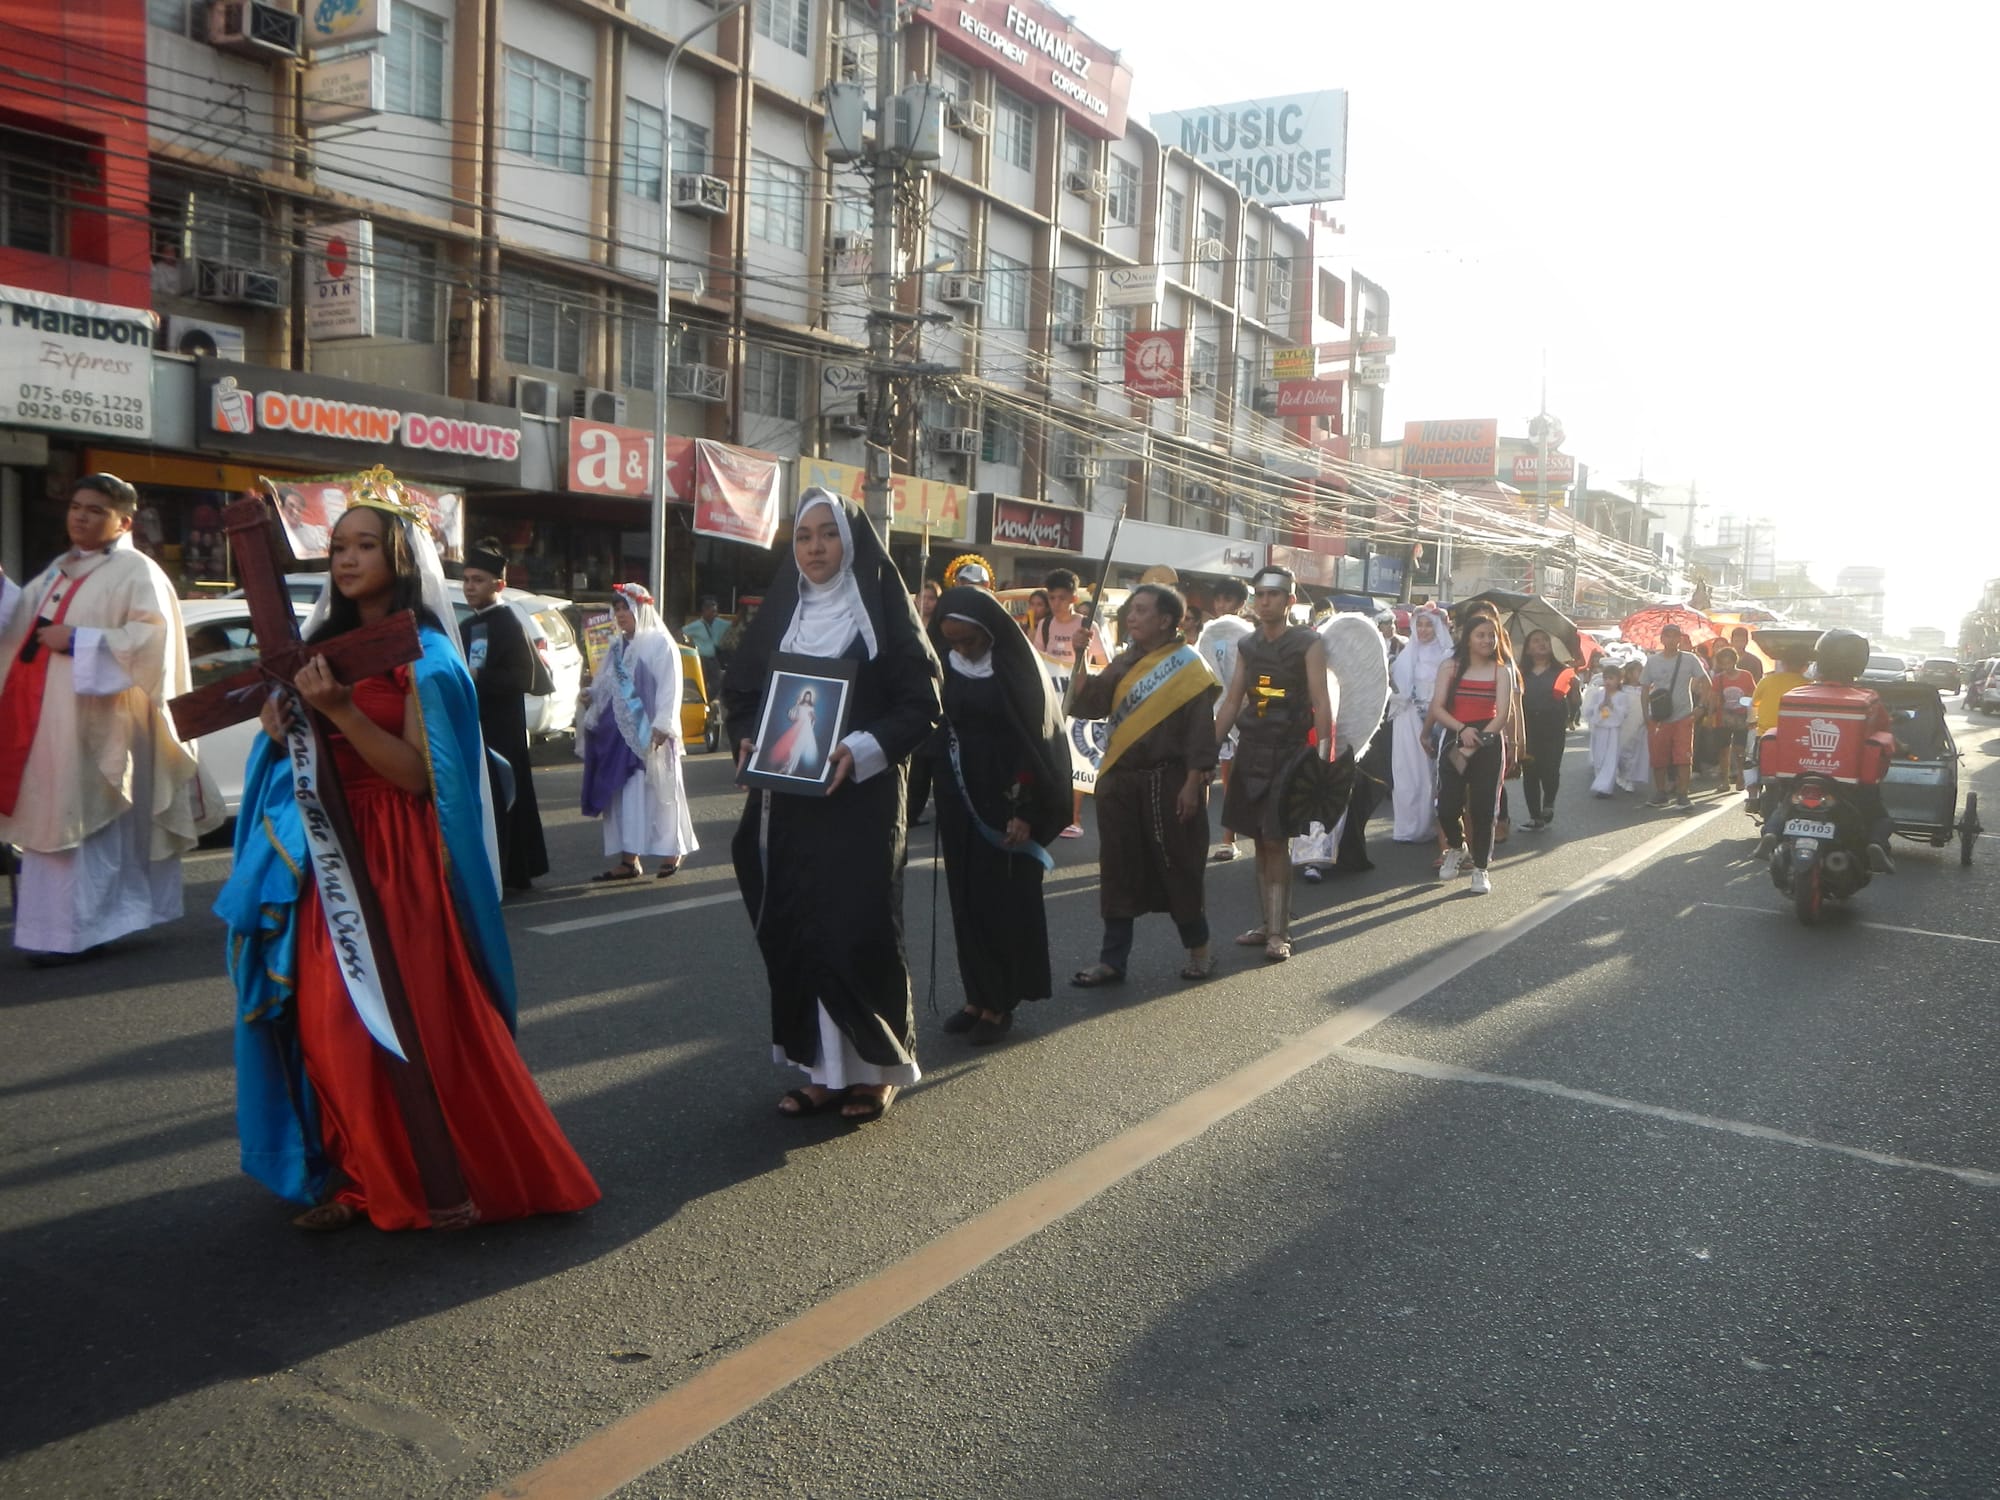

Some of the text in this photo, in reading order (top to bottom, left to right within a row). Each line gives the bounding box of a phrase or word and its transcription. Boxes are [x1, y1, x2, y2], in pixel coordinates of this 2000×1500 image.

[958, 10, 1029, 67] DEVELOPMENT
[1006, 4, 1091, 80] FERNANDEZ
[1051, 69, 1109, 118] CORPORATION
[1180, 104, 1303, 155] MUSIC
[1205, 148, 1331, 196] EHOUSE
[40, 341, 133, 379] Express
[17, 401, 145, 431] 0928-6761988
[20, 384, 143, 413] 075-696-1229
[1280, 390, 1302, 407] Red
[264, 395, 518, 459] DUNKIN' DONUTS
[1421, 420, 1484, 443] MUSIC
[1404, 445, 1491, 465] WAREHOUSE
[1515, 457, 1572, 469] ADESSA
[993, 507, 1061, 549] howking
[1788, 823, 1831, 834] 010103
[316, 849, 347, 904] True
[331, 910, 366, 984] Cross
